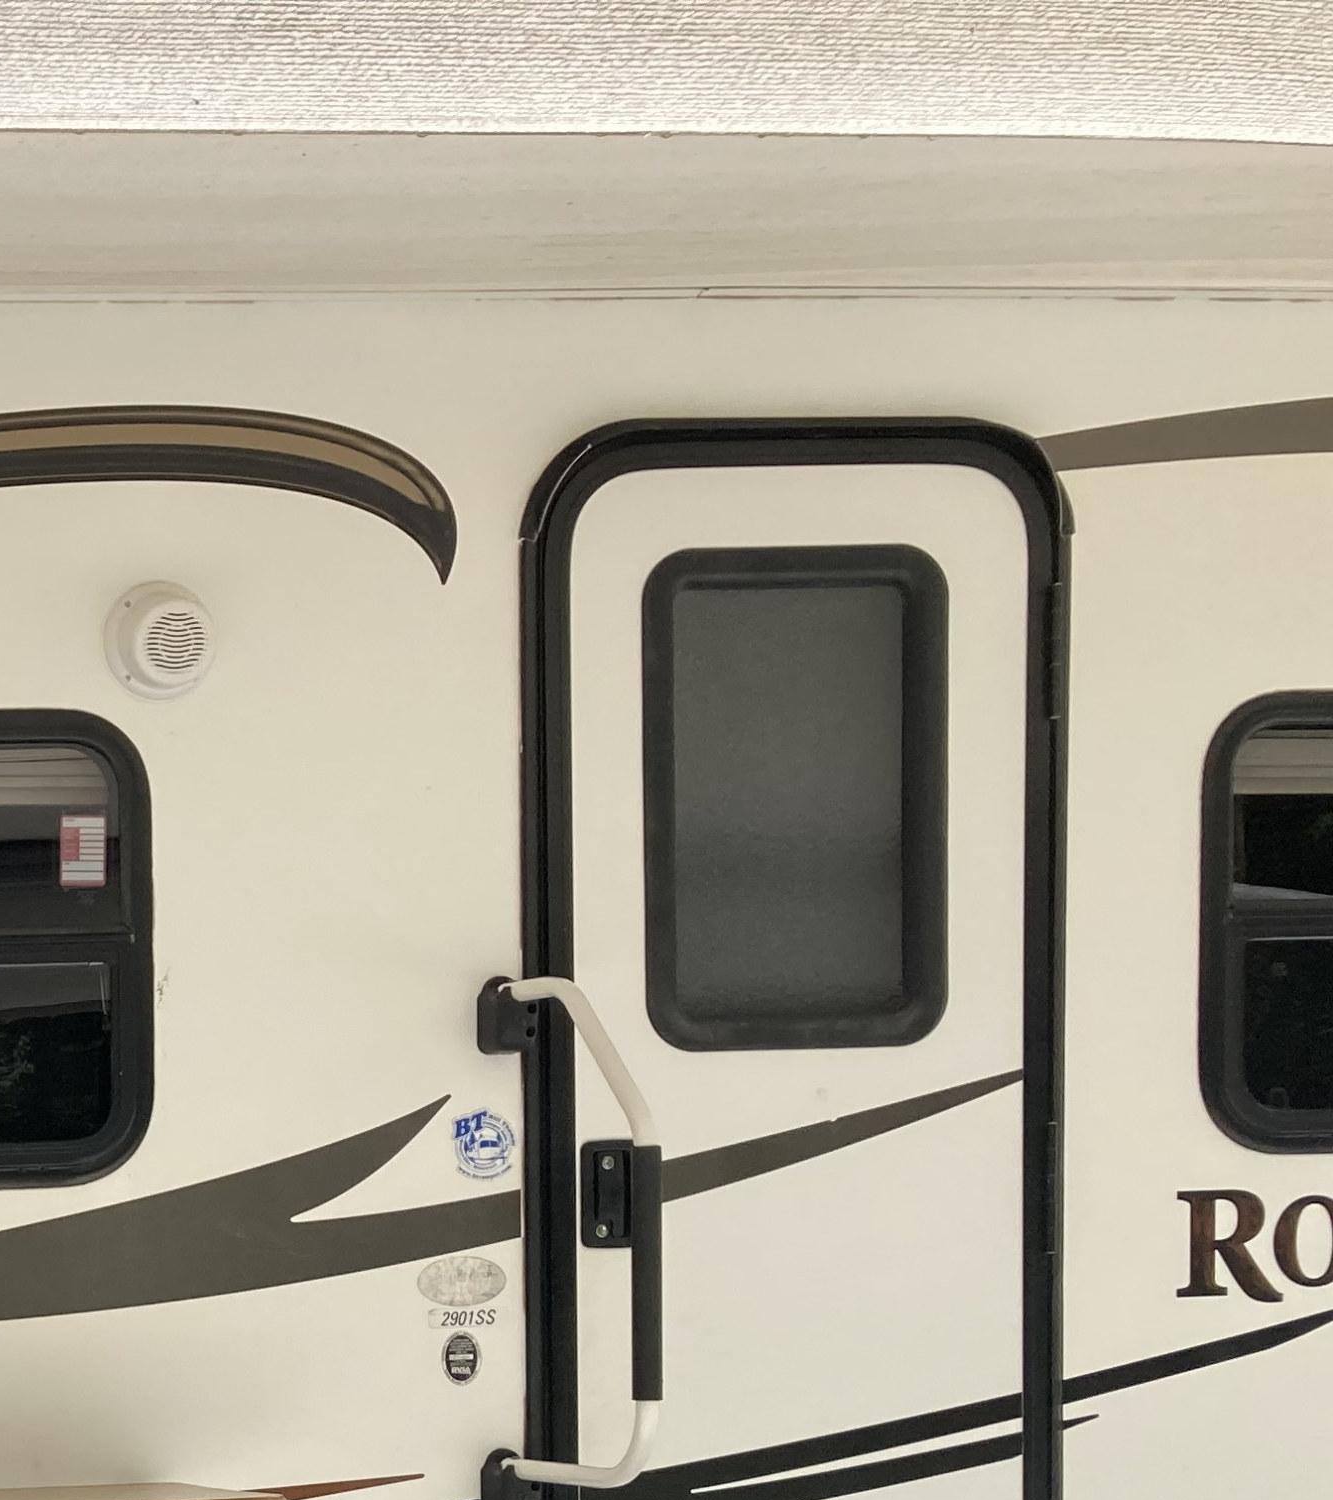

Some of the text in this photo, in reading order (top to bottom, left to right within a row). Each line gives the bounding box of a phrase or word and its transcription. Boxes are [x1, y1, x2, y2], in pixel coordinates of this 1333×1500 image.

[455, 1111, 487, 1138] BT
[1176, 1189, 1333, 1303] RO
[441, 1309, 496, 1326] 2901SS
